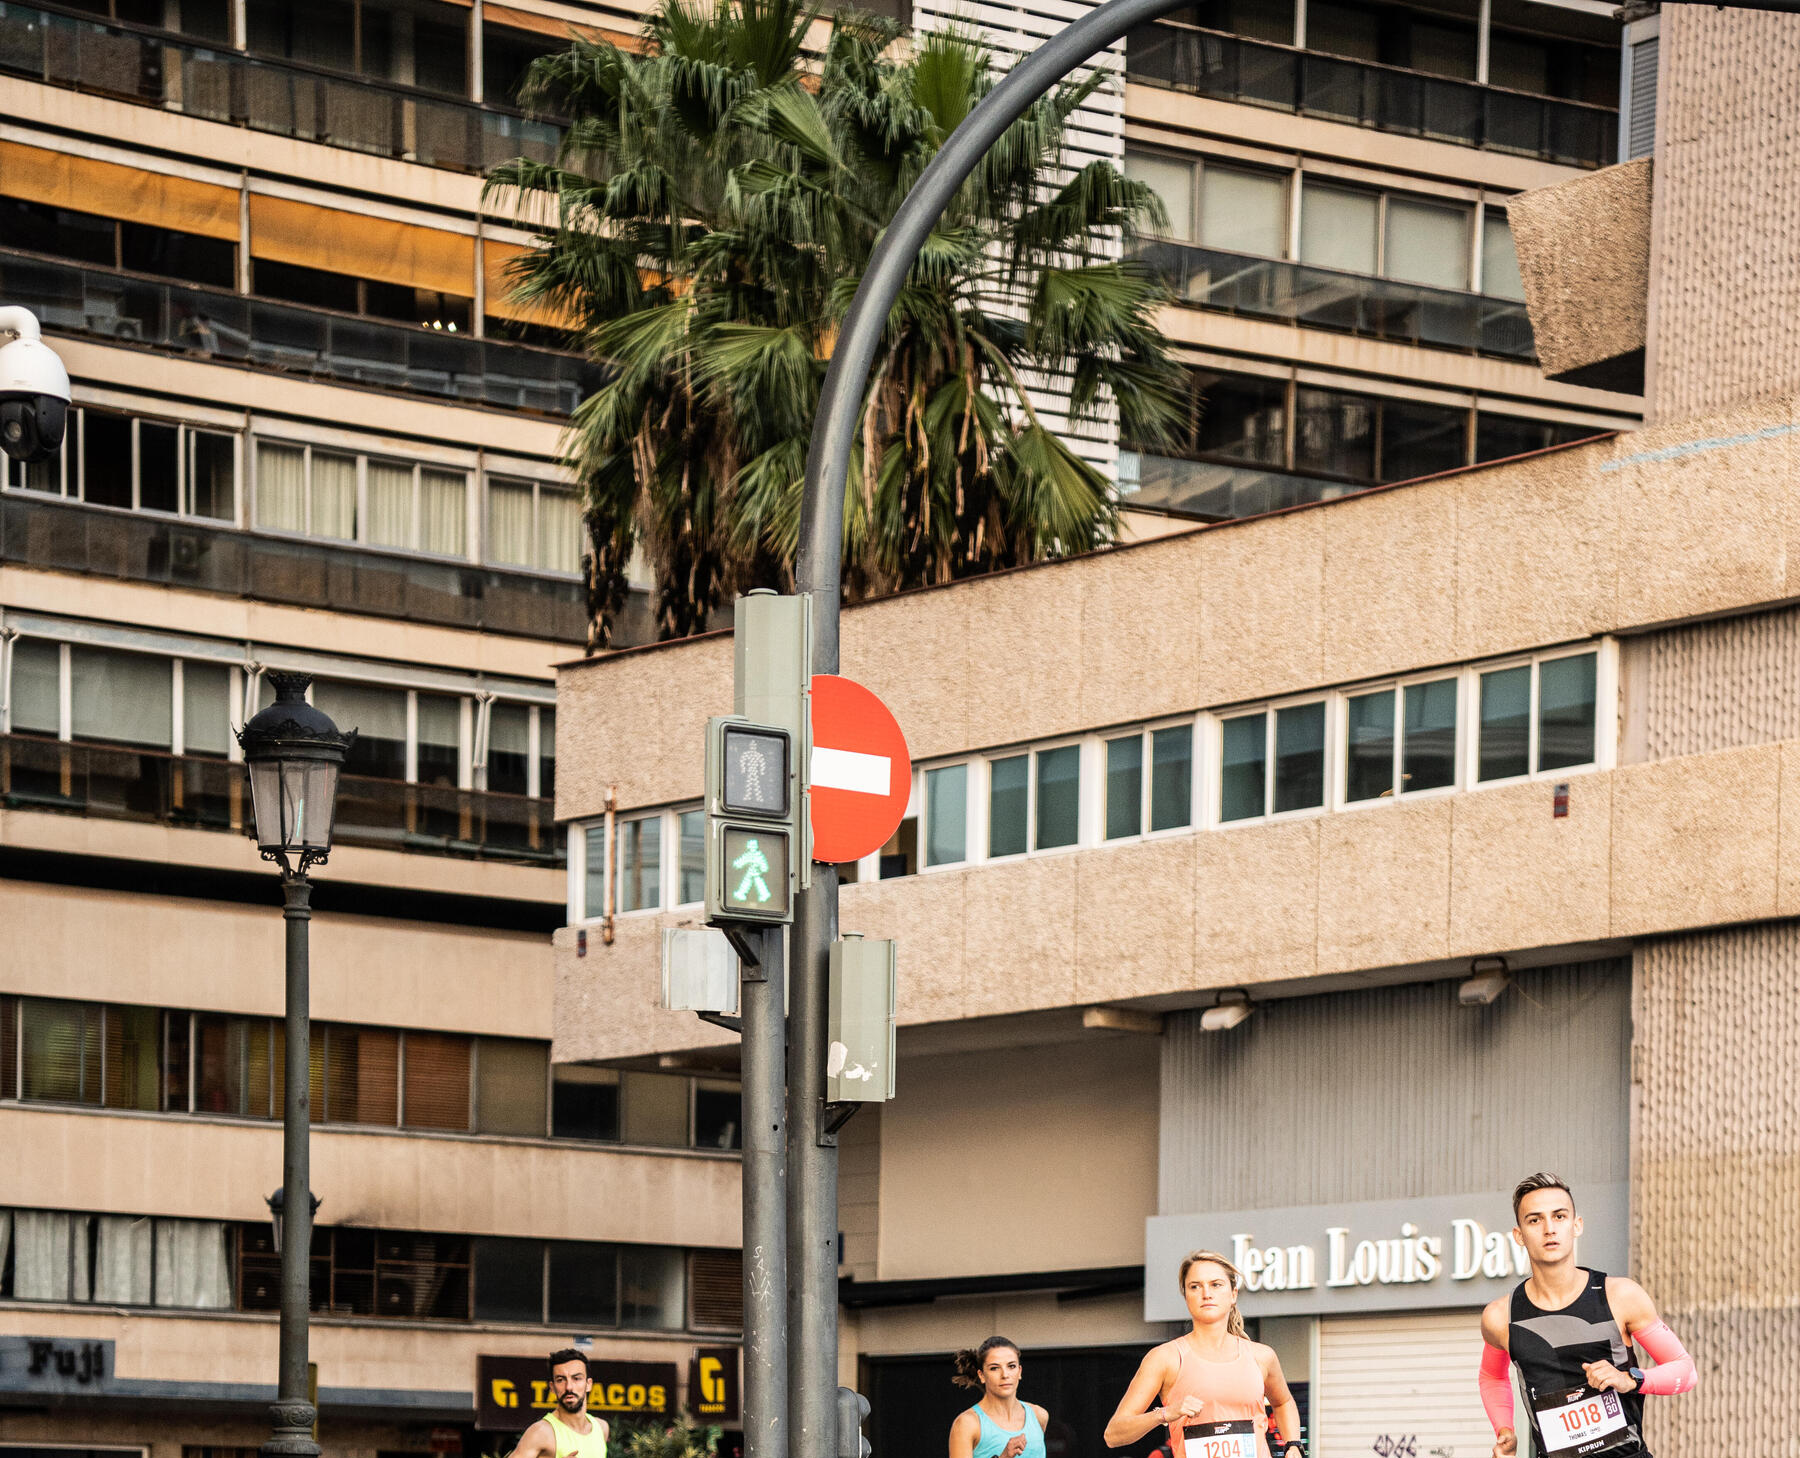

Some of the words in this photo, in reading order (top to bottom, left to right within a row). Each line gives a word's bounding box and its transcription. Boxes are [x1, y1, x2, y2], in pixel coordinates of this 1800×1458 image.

[1231, 1234, 1316, 1291] Jean
[1326, 1222, 1441, 1287] Louis
[28, 1341, 104, 1384] Fuji
[530, 1380, 666, 1407] TAACOS
[1603, 1393, 1615, 1405] 2H
[1559, 1403, 1602, 1432] 1018
[1606, 1403, 1618, 1415] 30
[1569, 1431, 1588, 1441] THOMAS
[1578, 1440, 1605, 1454] KIPRUN
